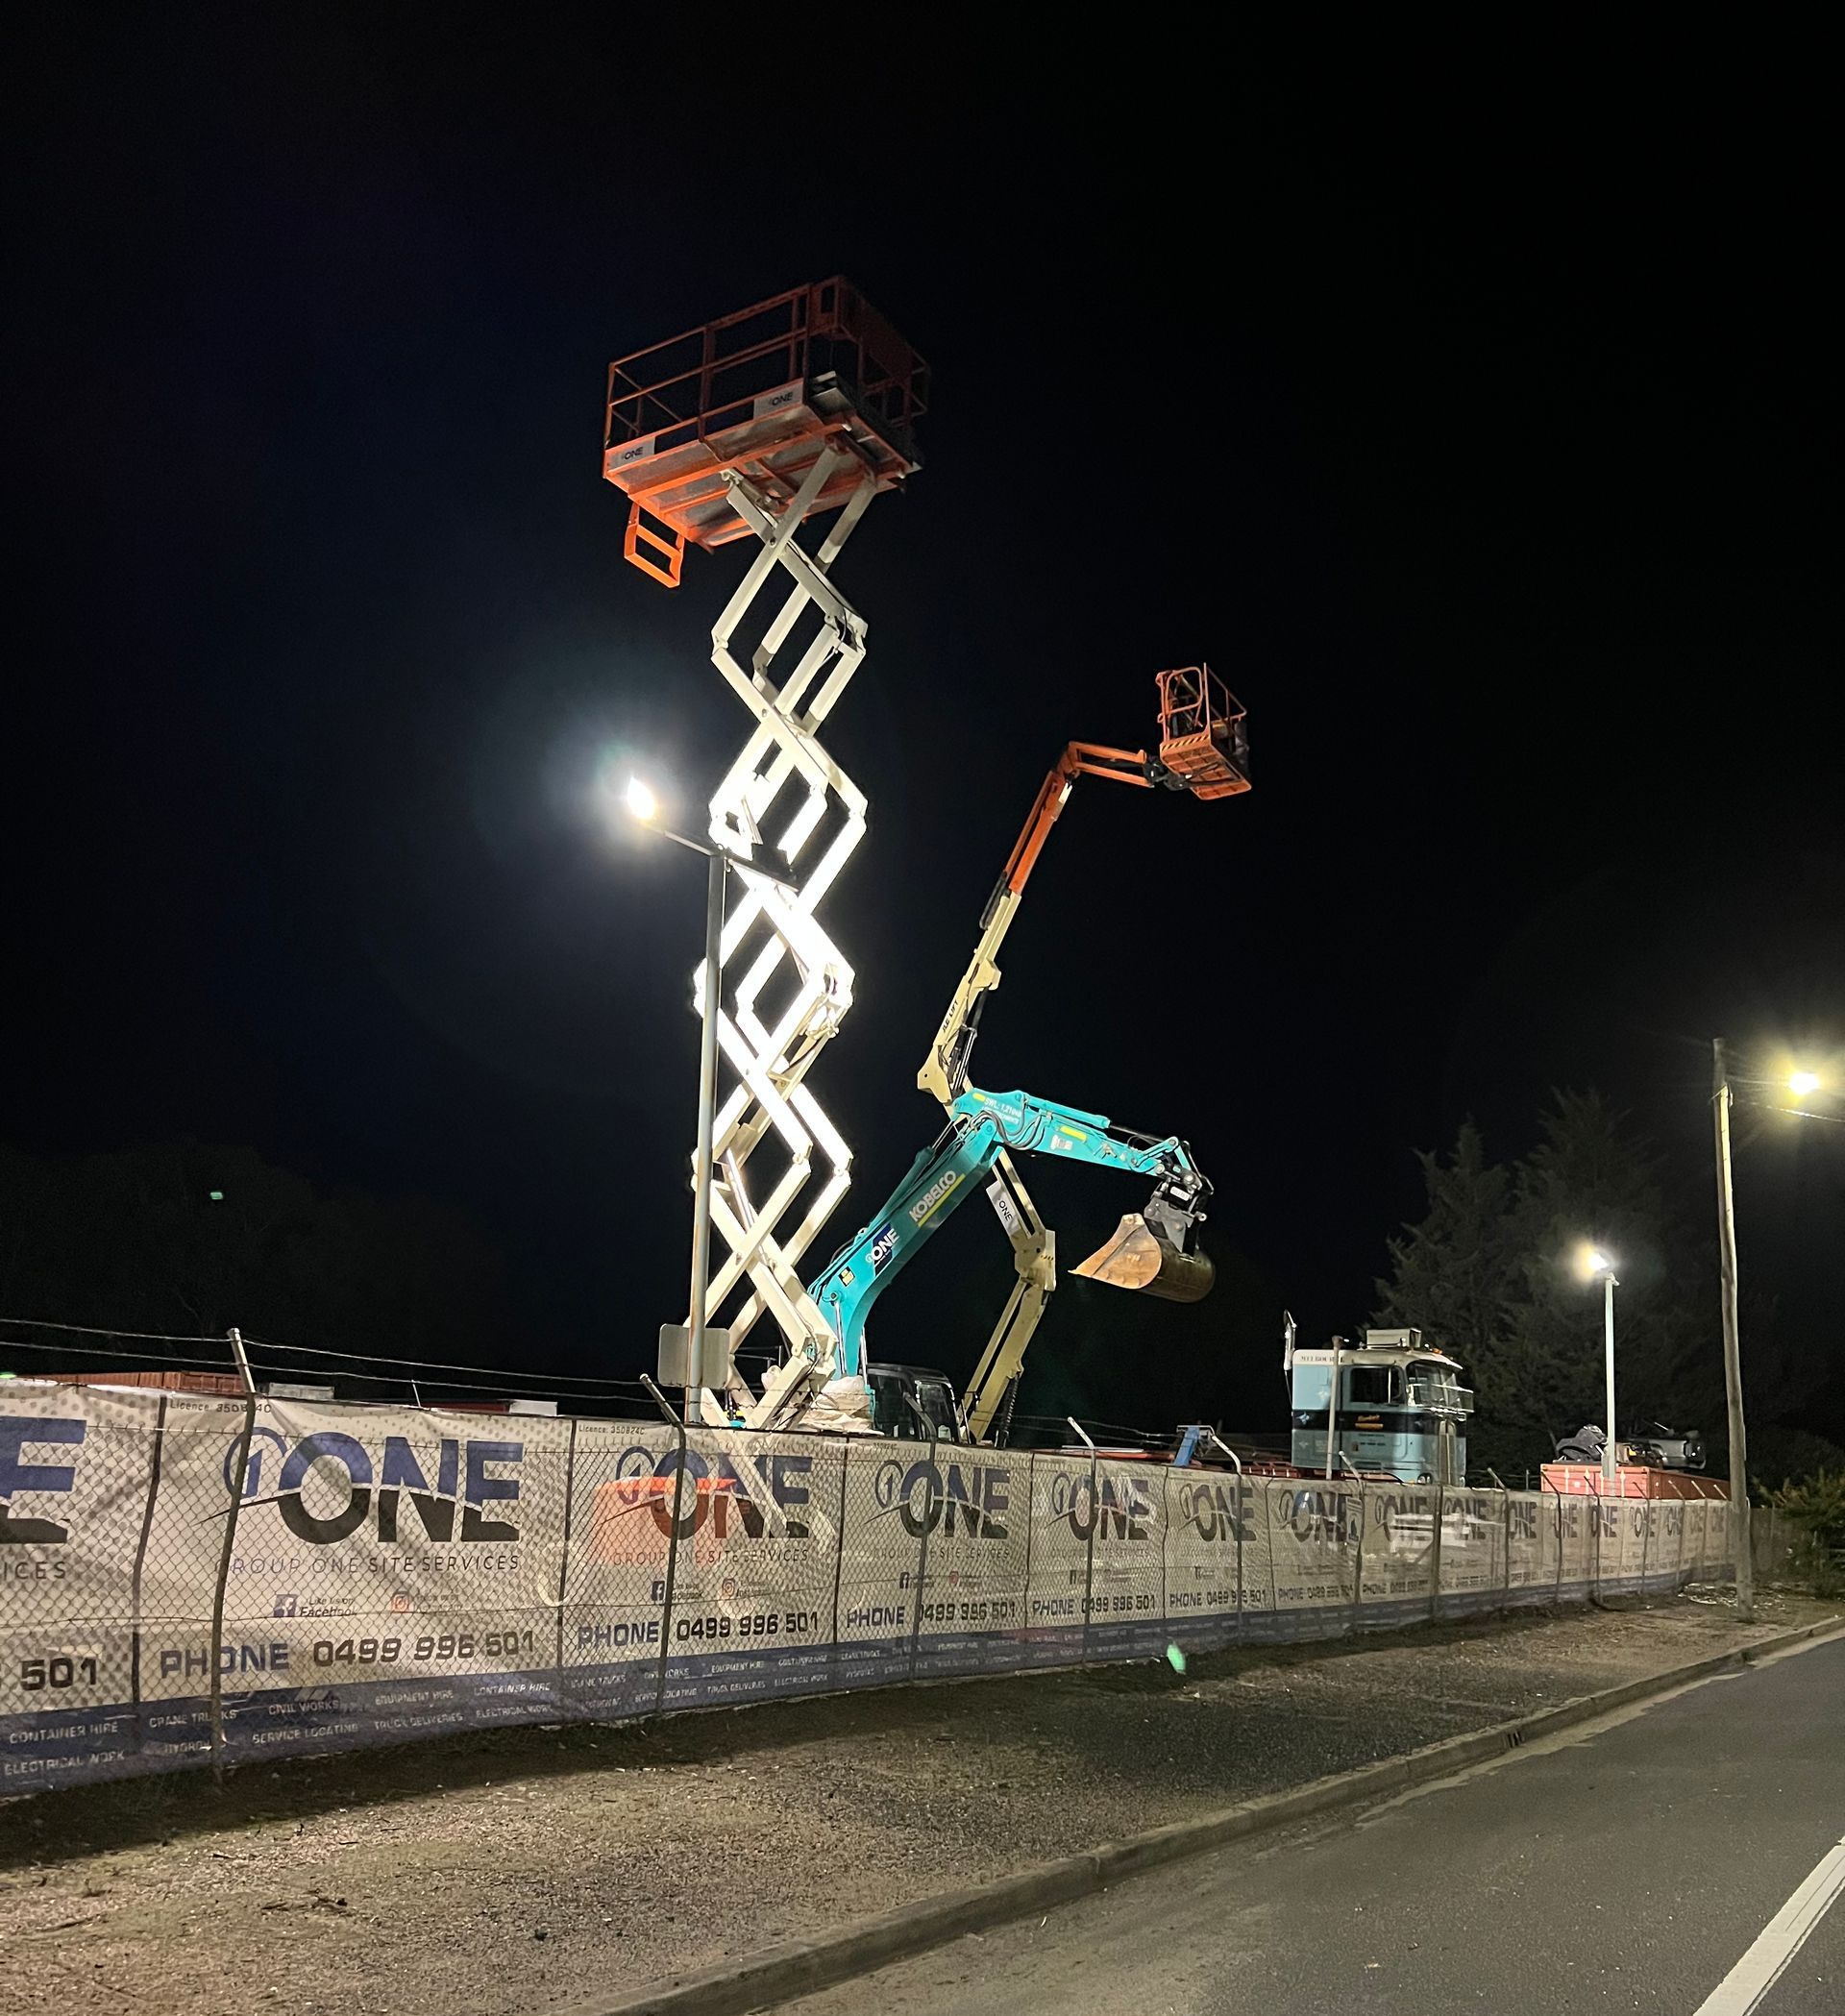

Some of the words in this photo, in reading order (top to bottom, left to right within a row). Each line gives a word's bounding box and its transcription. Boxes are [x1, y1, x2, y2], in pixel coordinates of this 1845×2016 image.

[773, 391, 793, 406] ONE
[624, 446, 644, 460] ONE
[909, 1170, 957, 1222] KOBELCO
[998, 1200, 1015, 1222] ONE
[871, 1228, 900, 1262] ONE
[278, 1431, 524, 1545] ONE
[651, 1448, 813, 1540] ONE
[899, 1459, 1010, 1539] ONE
[1069, 1474, 1149, 1541] ONE
[1193, 1484, 1257, 1542] ONE
[311, 1558, 359, 1574] ONE
[368, 1557, 414, 1573] SITE
[422, 1555, 519, 1572] SERVICES
[846, 1606, 906, 1629] PHONE
[961, 1601, 988, 1621] 996
[992, 1600, 1016, 1620] 501
[1032, 1598, 1074, 1616] PHONE
[1113, 1595, 1134, 1612] 996
[1169, 1592, 1203, 1608] PHONE
[1207, 1591, 1229, 1605] 0499
[1249, 1588, 1267, 1603] 501
[578, 1621, 660, 1652] PHONE
[676, 1615, 731, 1641] 0499
[739, 1613, 779, 1636] 996
[785, 1610, 818, 1634] 501
[160, 1642, 289, 1679] PHONE
[312, 1636, 402, 1668] 0499
[413, 1634, 475, 1661] 996
[485, 1630, 534, 1658] 501
[20, 1657, 97, 1691] 501
[10, 1726, 86, 1744] CONTAINER
[4, 1757, 85, 1776] ELECTRICAL
